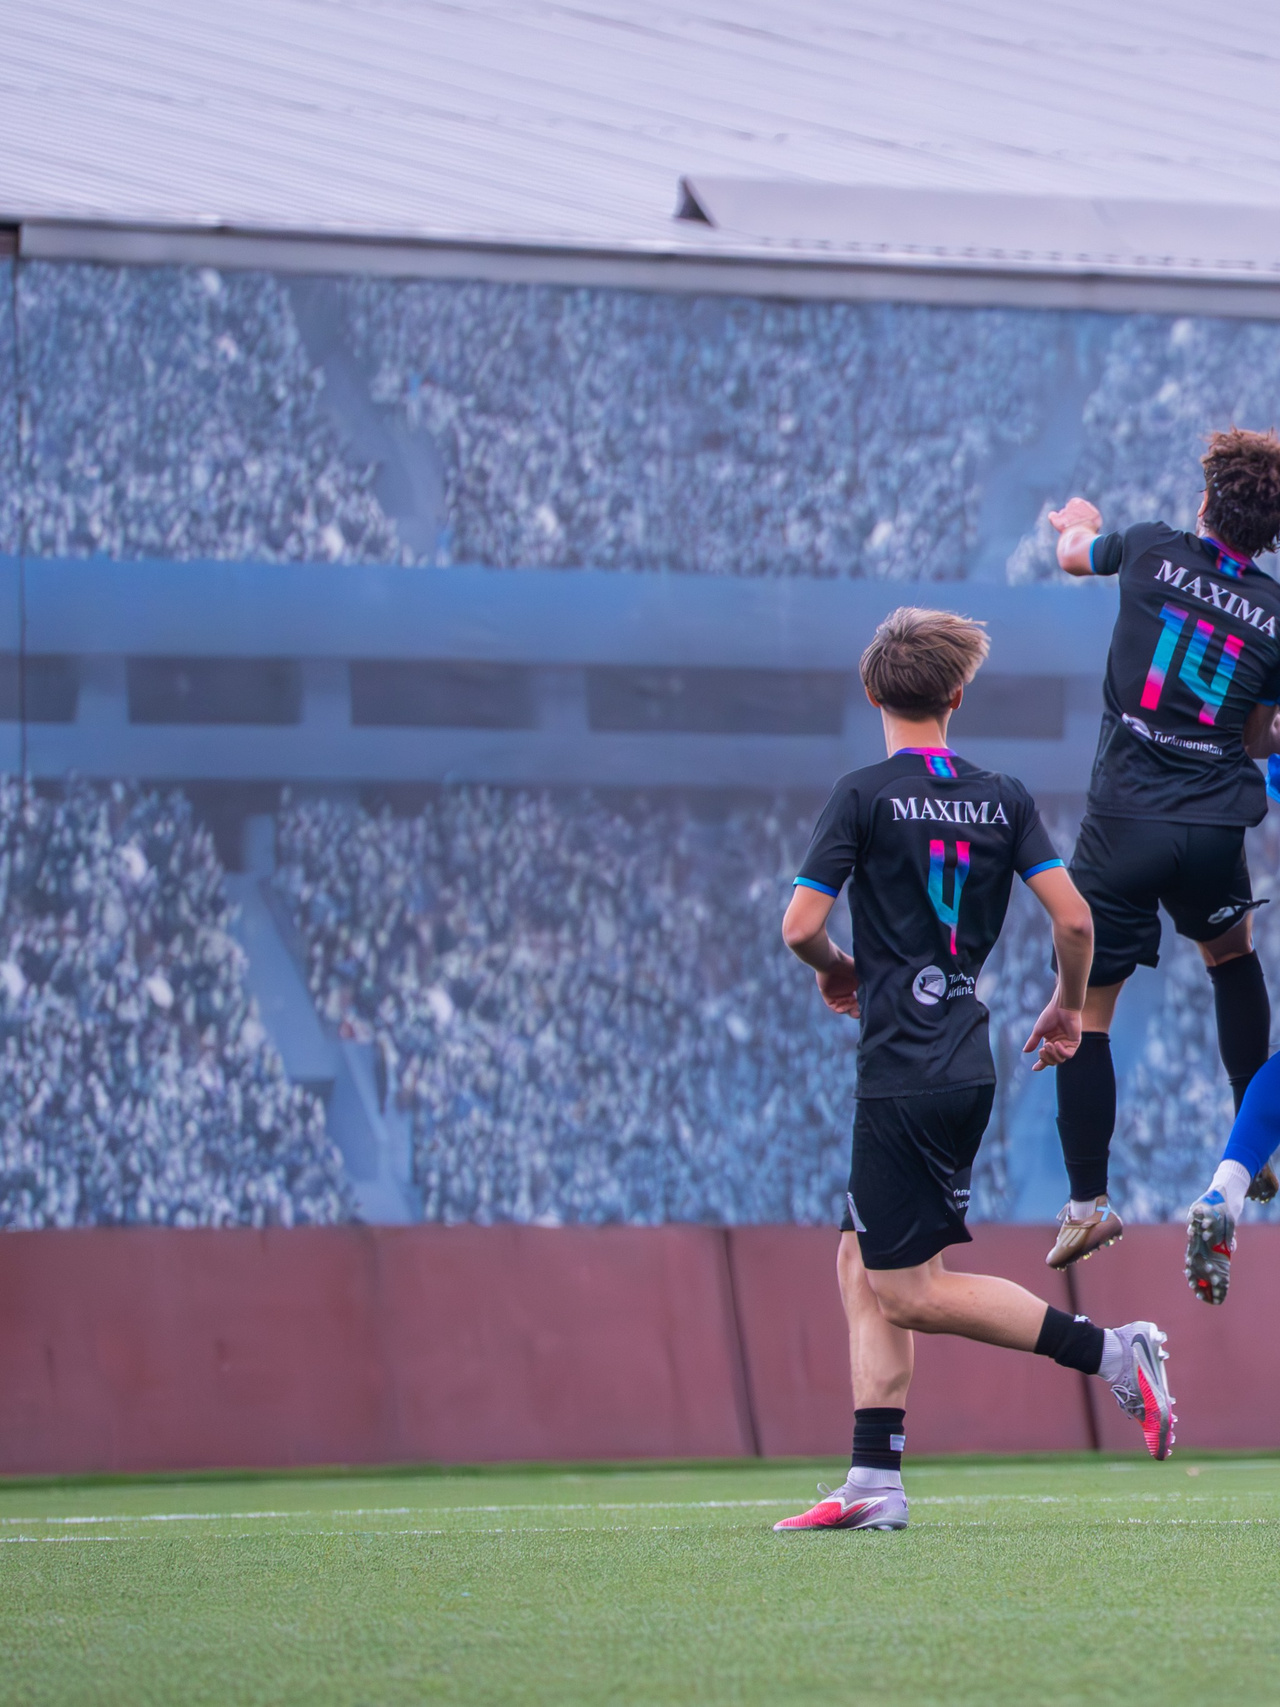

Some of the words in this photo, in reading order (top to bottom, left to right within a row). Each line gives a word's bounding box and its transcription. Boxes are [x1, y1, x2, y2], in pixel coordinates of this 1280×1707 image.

[1154, 559, 1277, 638] MAXIMA
[1140, 602, 1245, 726] 14
[890, 797, 1011, 826] MAXIMA
[927, 839, 971, 956] 4
